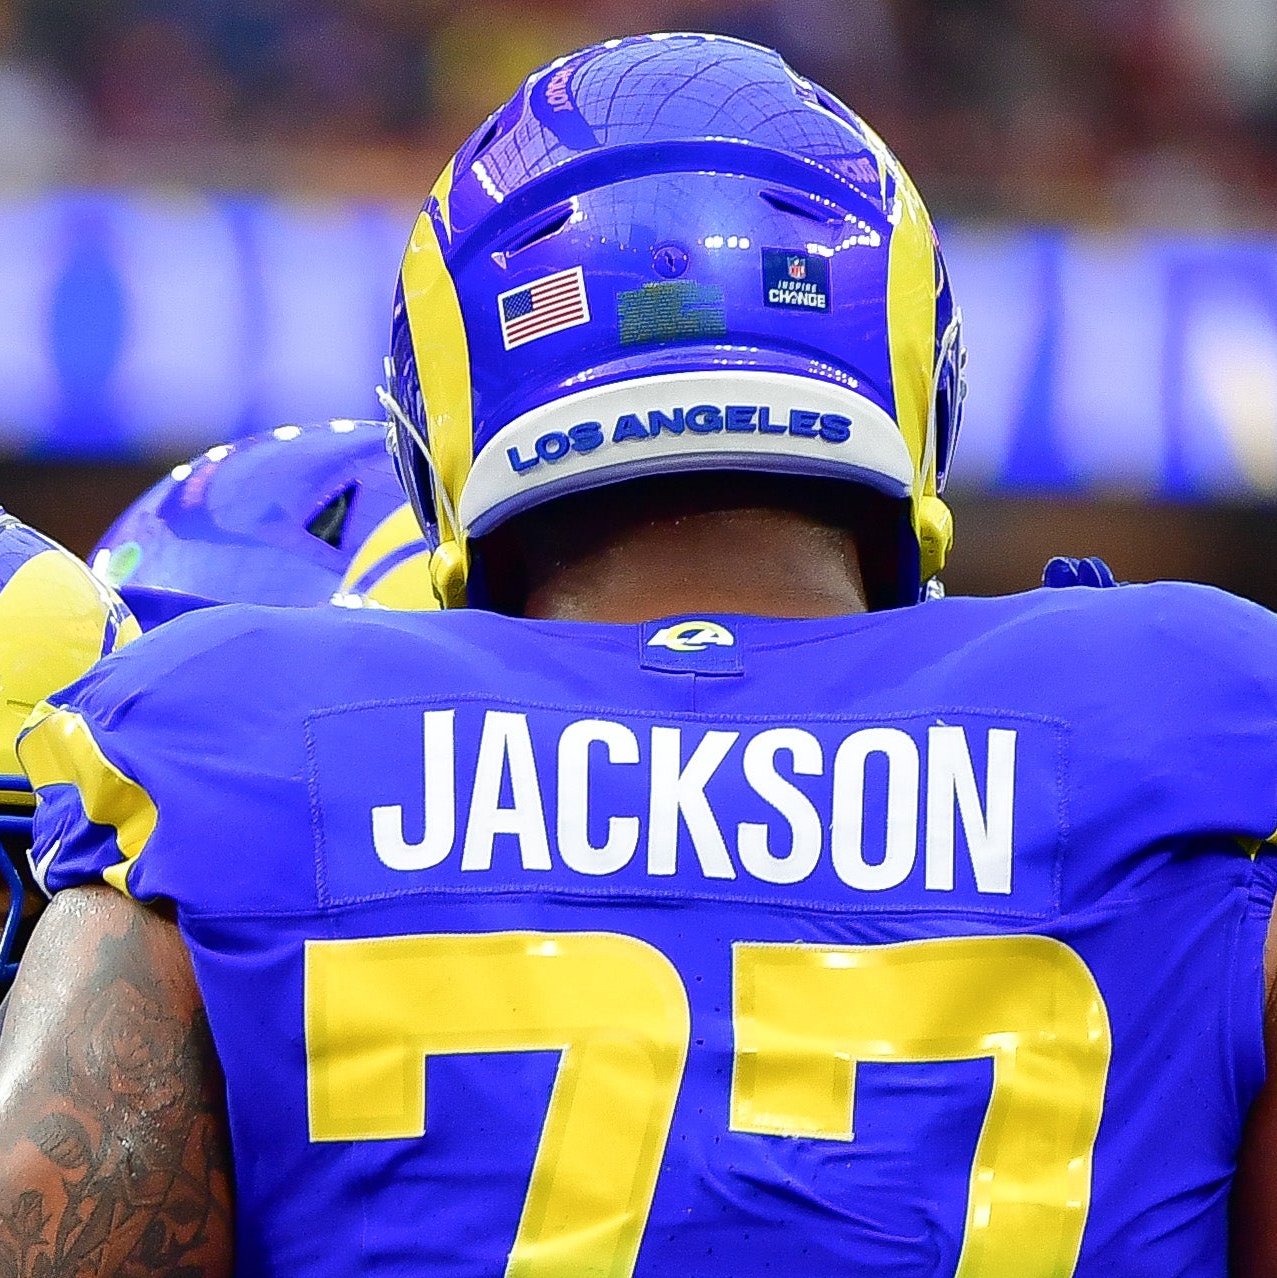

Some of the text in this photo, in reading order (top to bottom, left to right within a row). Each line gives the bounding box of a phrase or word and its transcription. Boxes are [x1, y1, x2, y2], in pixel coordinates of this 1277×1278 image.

[769, 289, 827, 308] CHANGE
[778, 280, 818, 292] INSPIRE
[506, 405, 852, 472] LOS ANGELES
[371, 709, 1017, 894] JACKSON
